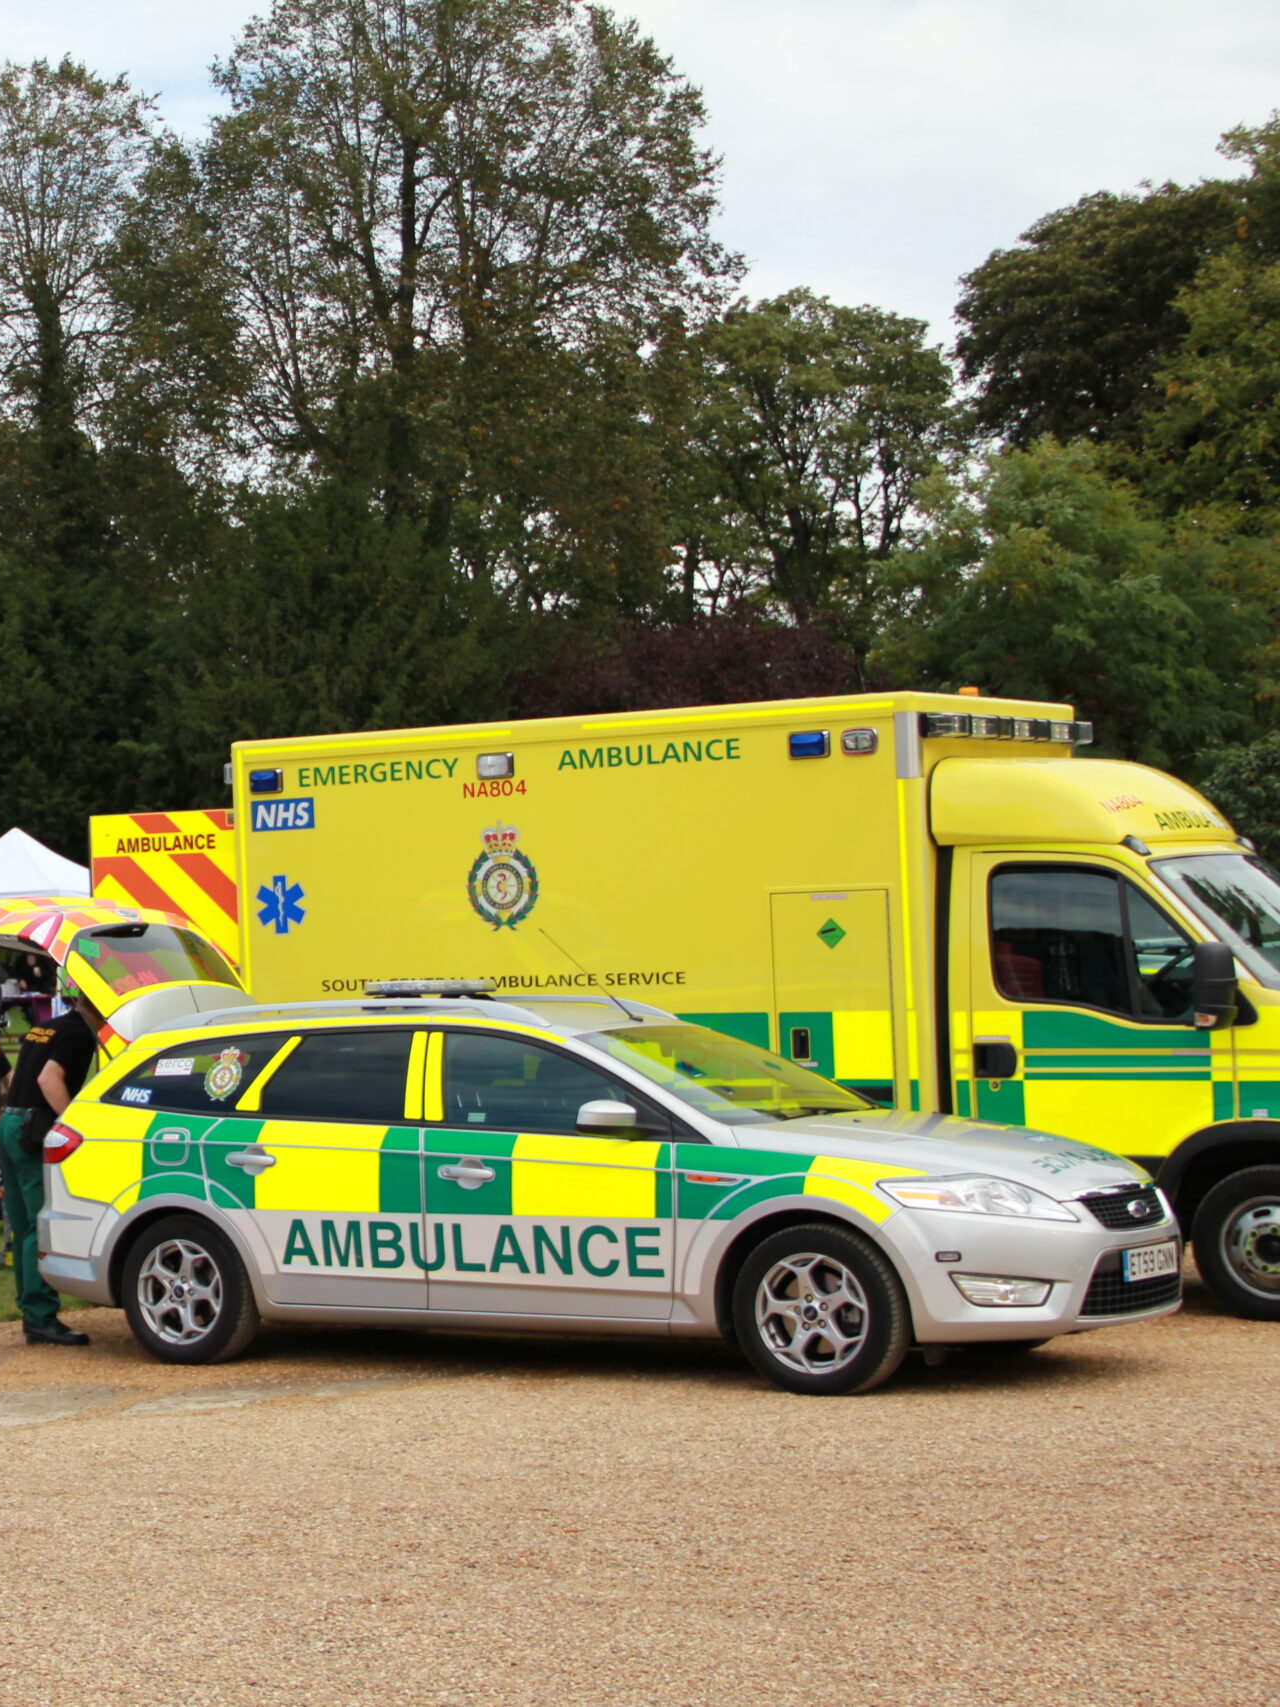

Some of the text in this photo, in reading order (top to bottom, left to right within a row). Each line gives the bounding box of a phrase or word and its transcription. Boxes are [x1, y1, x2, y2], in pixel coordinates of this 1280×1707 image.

[557, 738, 741, 771] AMBULANCE
[298, 757, 459, 788] EMERGENCY
[462, 779, 527, 799] NA804
[255, 801, 310, 829] NHS
[116, 833, 216, 854] AMBULANCE
[321, 978, 380, 993] SOUT
[482, 974, 597, 988] MBULANCE
[605, 971, 687, 986] SERVICE
[157, 1058, 193, 1069] serco
[121, 1087, 152, 1103] NHS
[281, 1218, 666, 1279] AMBULANCE
[1129, 1251, 1154, 1275] ET59
